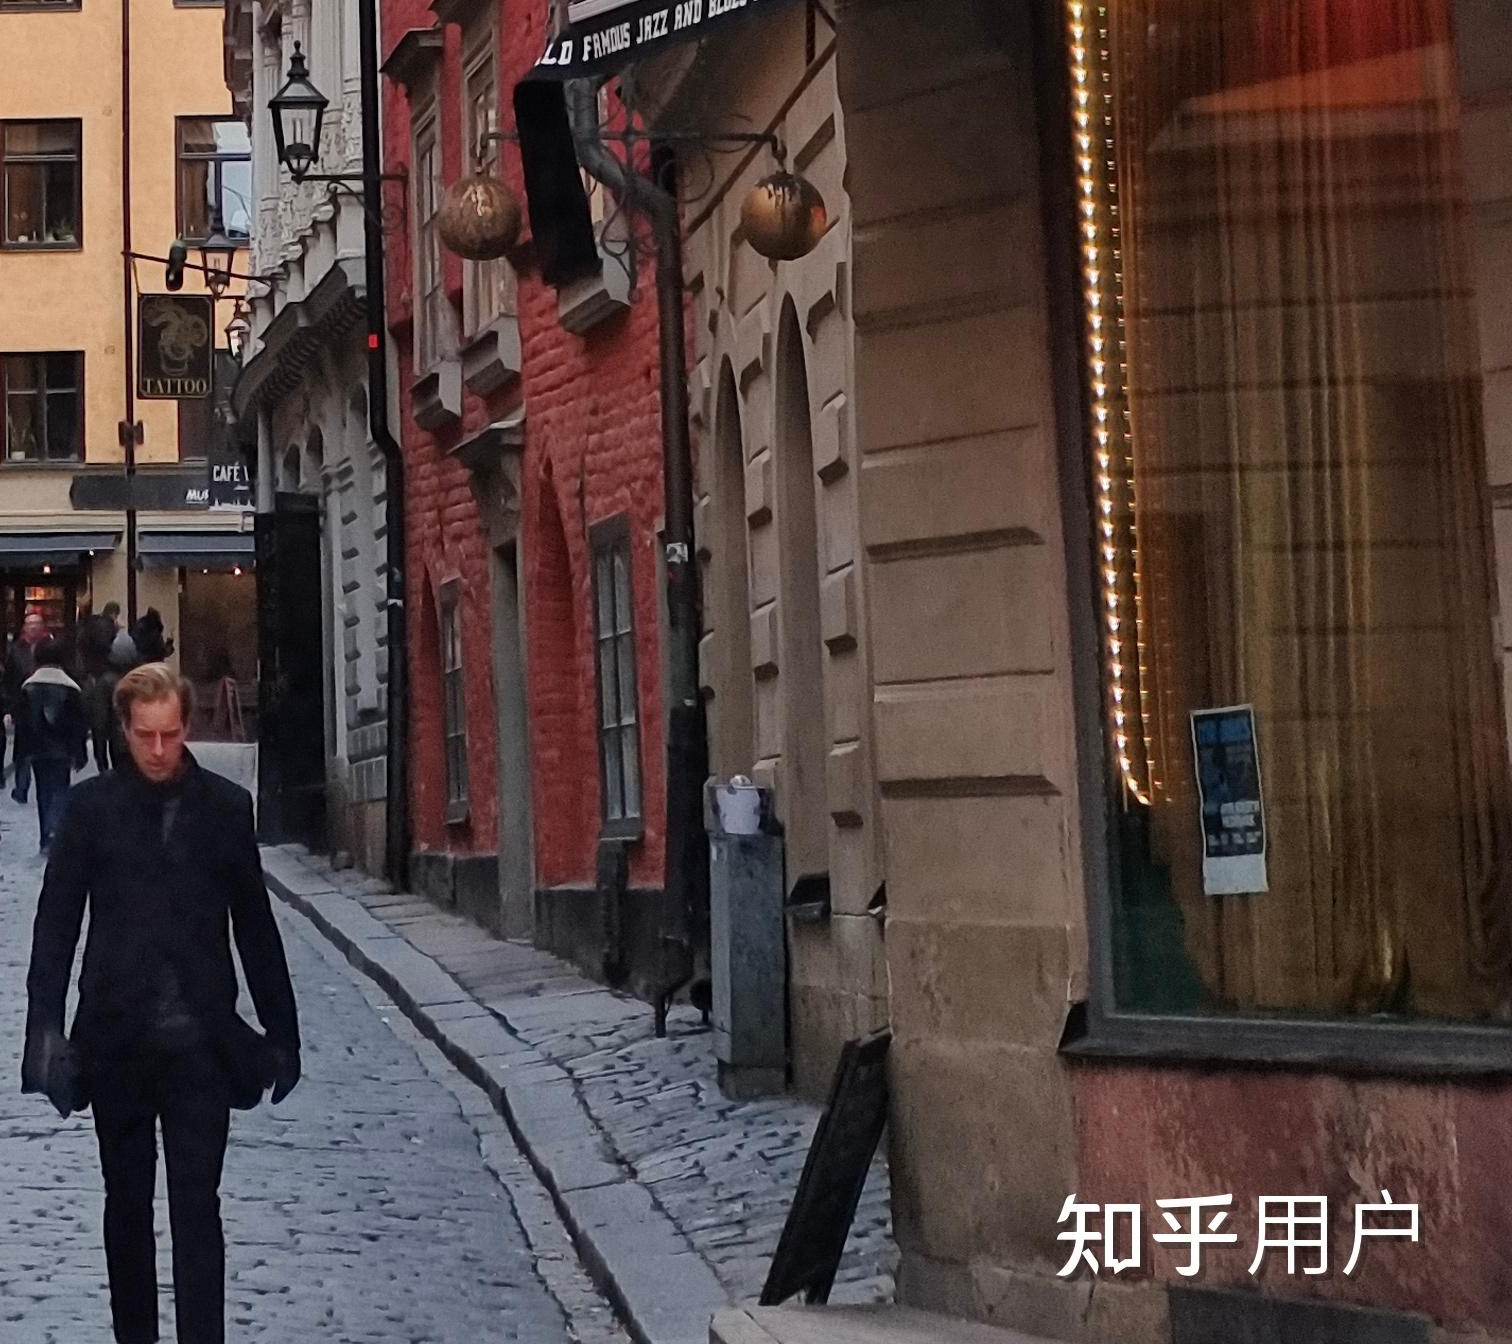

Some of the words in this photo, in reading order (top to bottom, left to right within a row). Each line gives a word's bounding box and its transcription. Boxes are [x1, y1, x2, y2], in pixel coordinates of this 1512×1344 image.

[534, 40, 573, 66] LD
[582, 22, 630, 61] FAMOUS
[637, 9, 669, 44] JAZZ
[144, 377, 207, 394] TATTOO
[213, 461, 241, 482] CAFÉ
